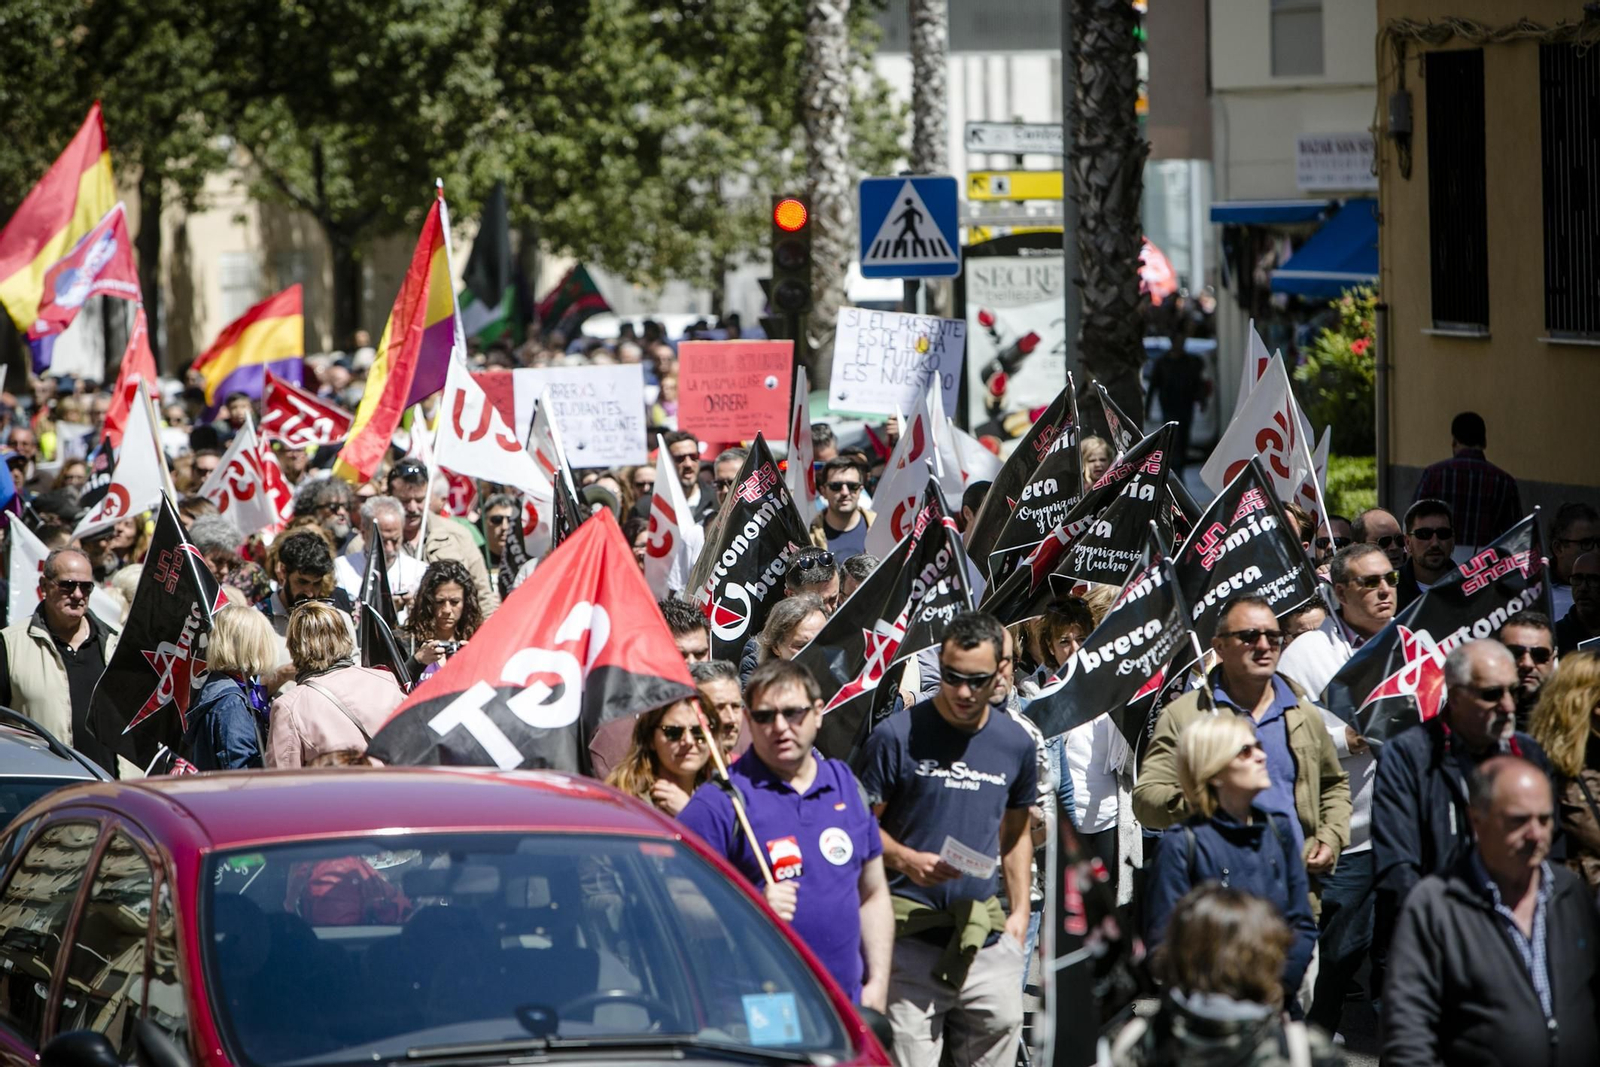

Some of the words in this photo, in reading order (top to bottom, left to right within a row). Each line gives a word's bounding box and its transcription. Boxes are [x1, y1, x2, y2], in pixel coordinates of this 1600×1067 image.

[845, 310, 861, 328] SI
[869, 312, 887, 330] EL
[899, 315, 963, 338] PRESENTE
[858, 328, 877, 347] ES
[881, 330, 897, 350] DE
[843, 362, 868, 382] ES
[882, 350, 941, 372] FUTURO
[553, 401, 622, 416] STUDIANTES
[1087, 554, 1129, 573] lucha
[1459, 547, 1499, 579] un
